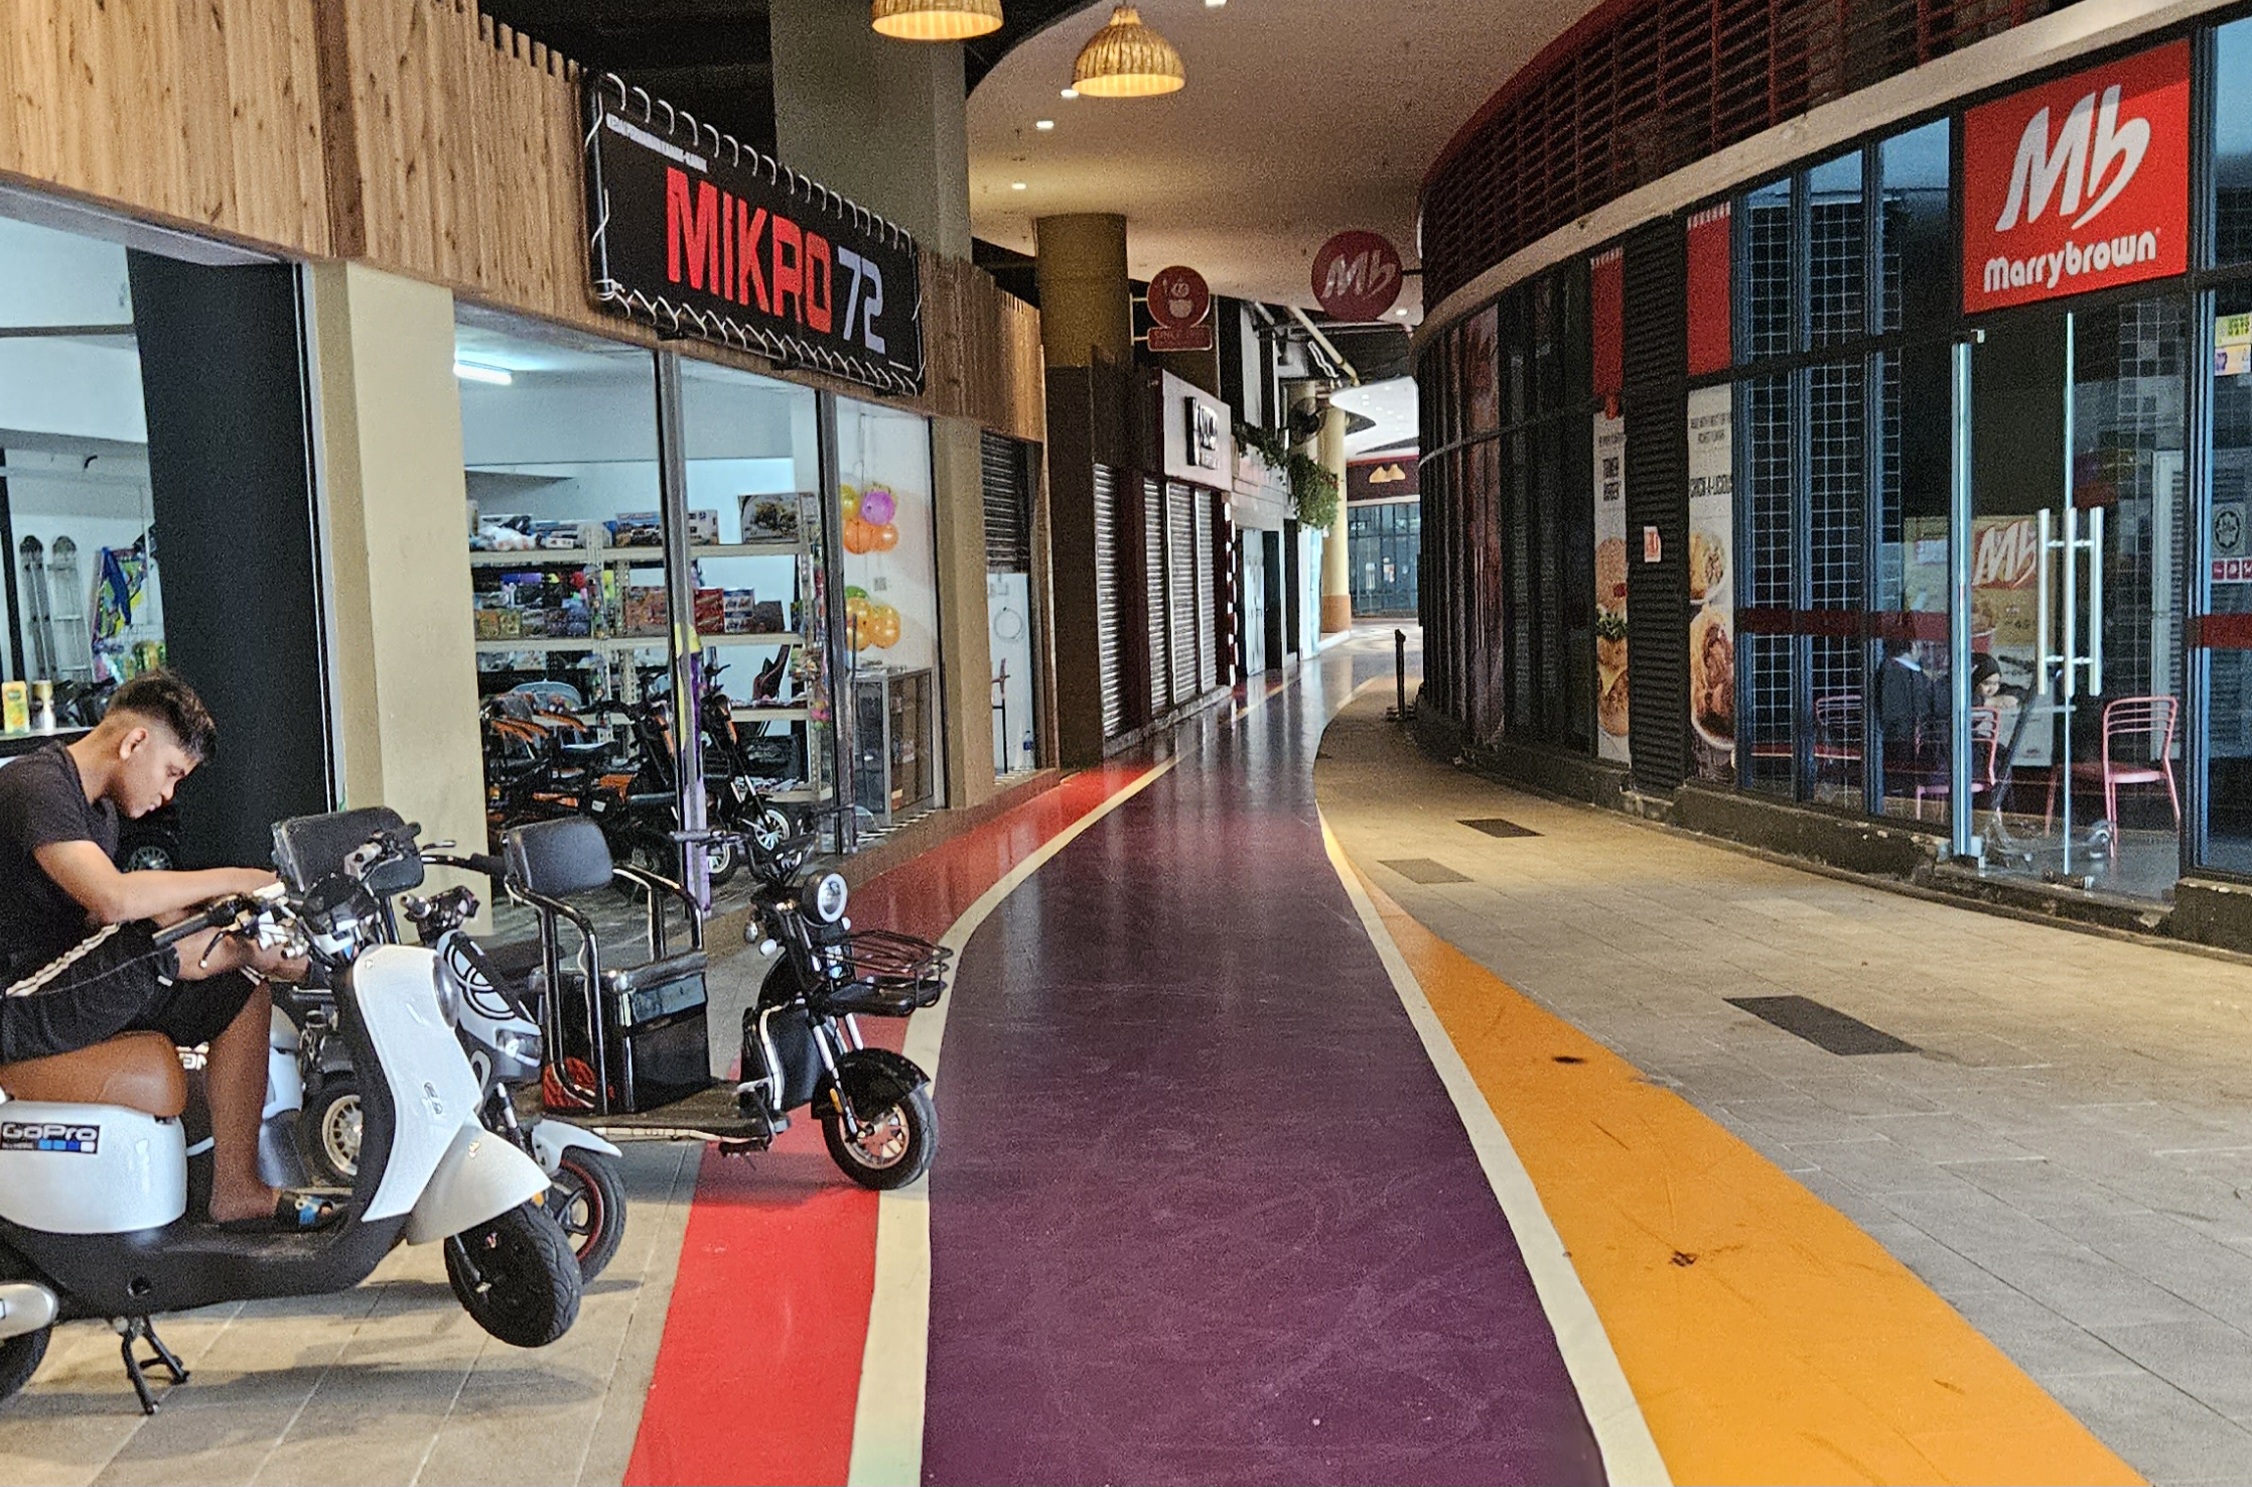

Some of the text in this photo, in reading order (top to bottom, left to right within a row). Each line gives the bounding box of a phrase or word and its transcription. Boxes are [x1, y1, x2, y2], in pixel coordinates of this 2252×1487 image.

[1995, 84, 2150, 232] Mb
[667, 166, 886, 355] MIKRO 72
[1321, 250, 1397, 300] Mb
[2, 1123, 98, 1142] GoPro
